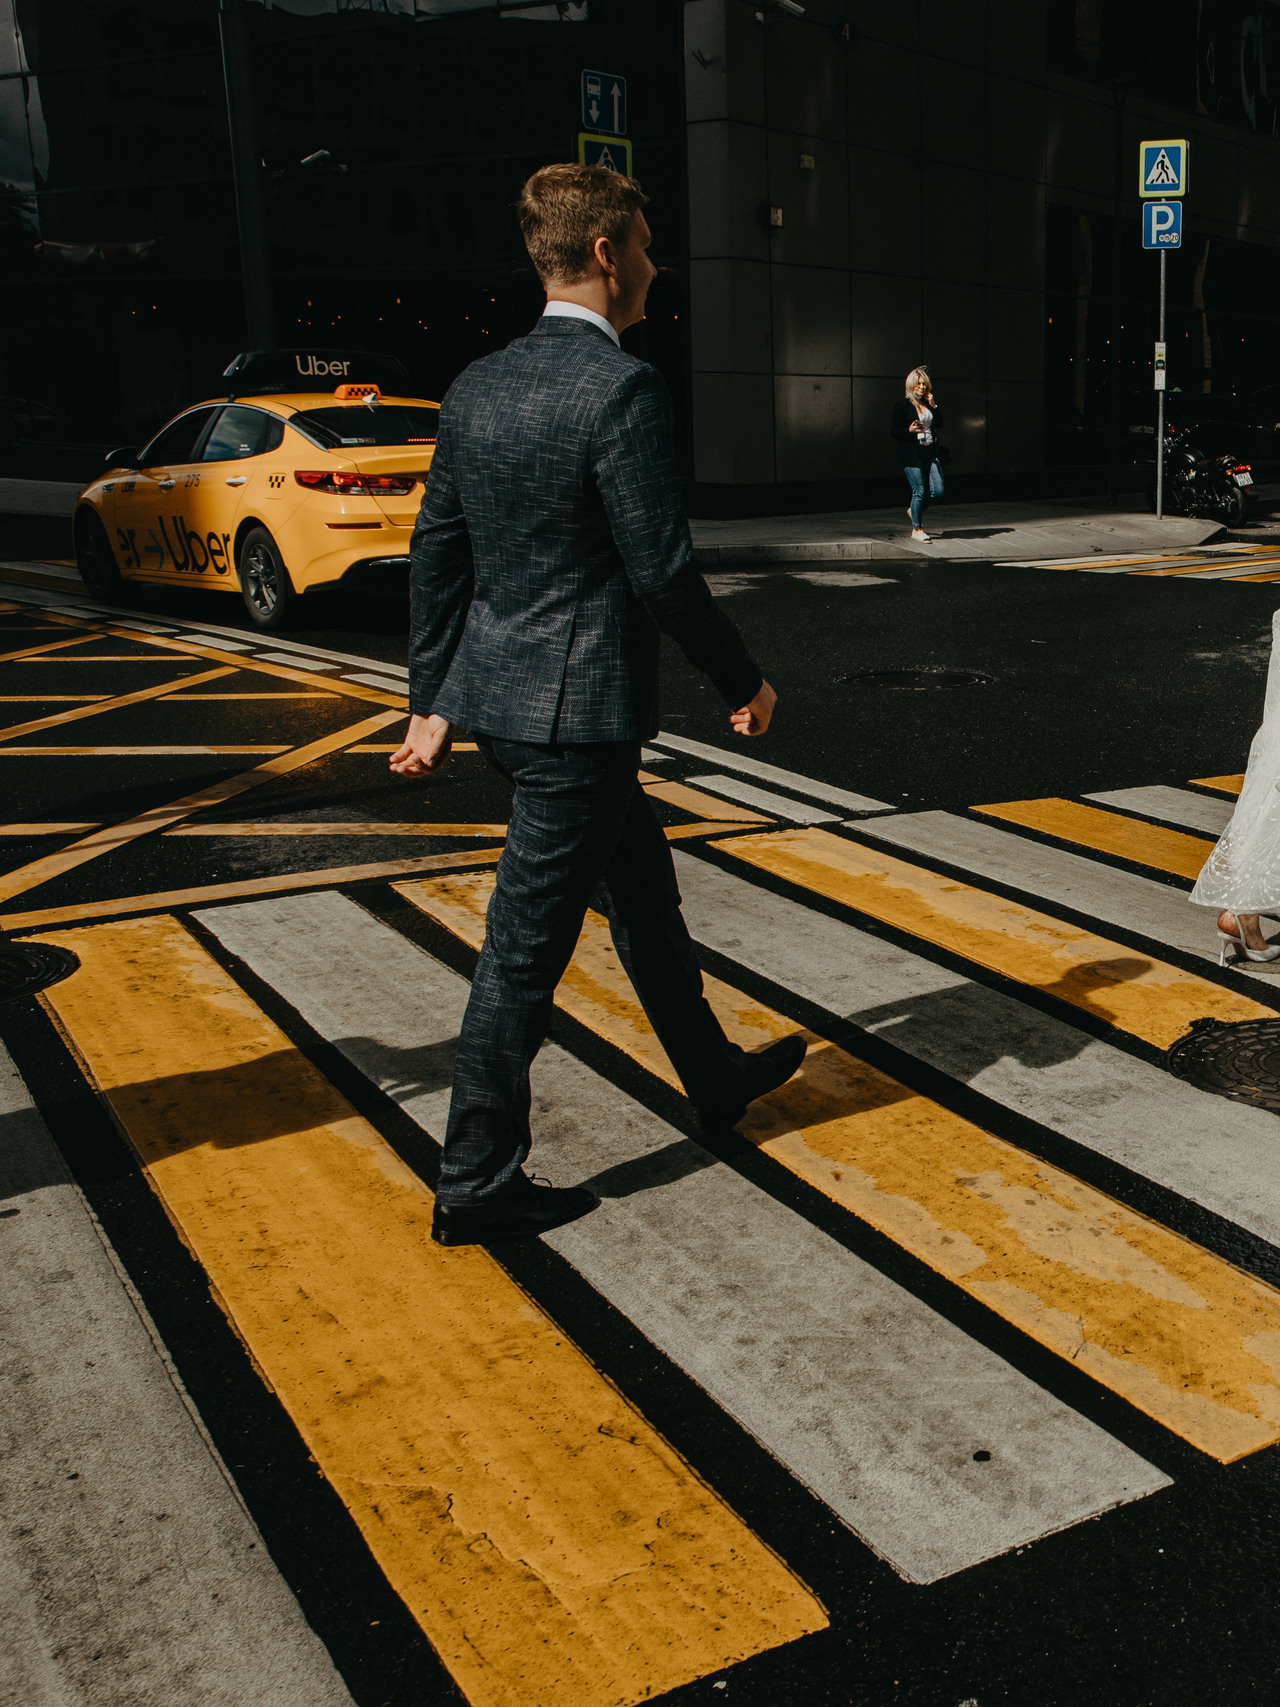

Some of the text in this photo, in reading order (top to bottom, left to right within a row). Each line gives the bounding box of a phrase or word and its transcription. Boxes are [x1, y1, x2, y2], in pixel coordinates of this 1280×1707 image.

[841, 22, 850, 41] 4
[1151, 205, 1175, 245] P
[295, 354, 351, 377] Uber
[184, 473, 201, 488] 275
[158, 515, 231, 575] Uber
